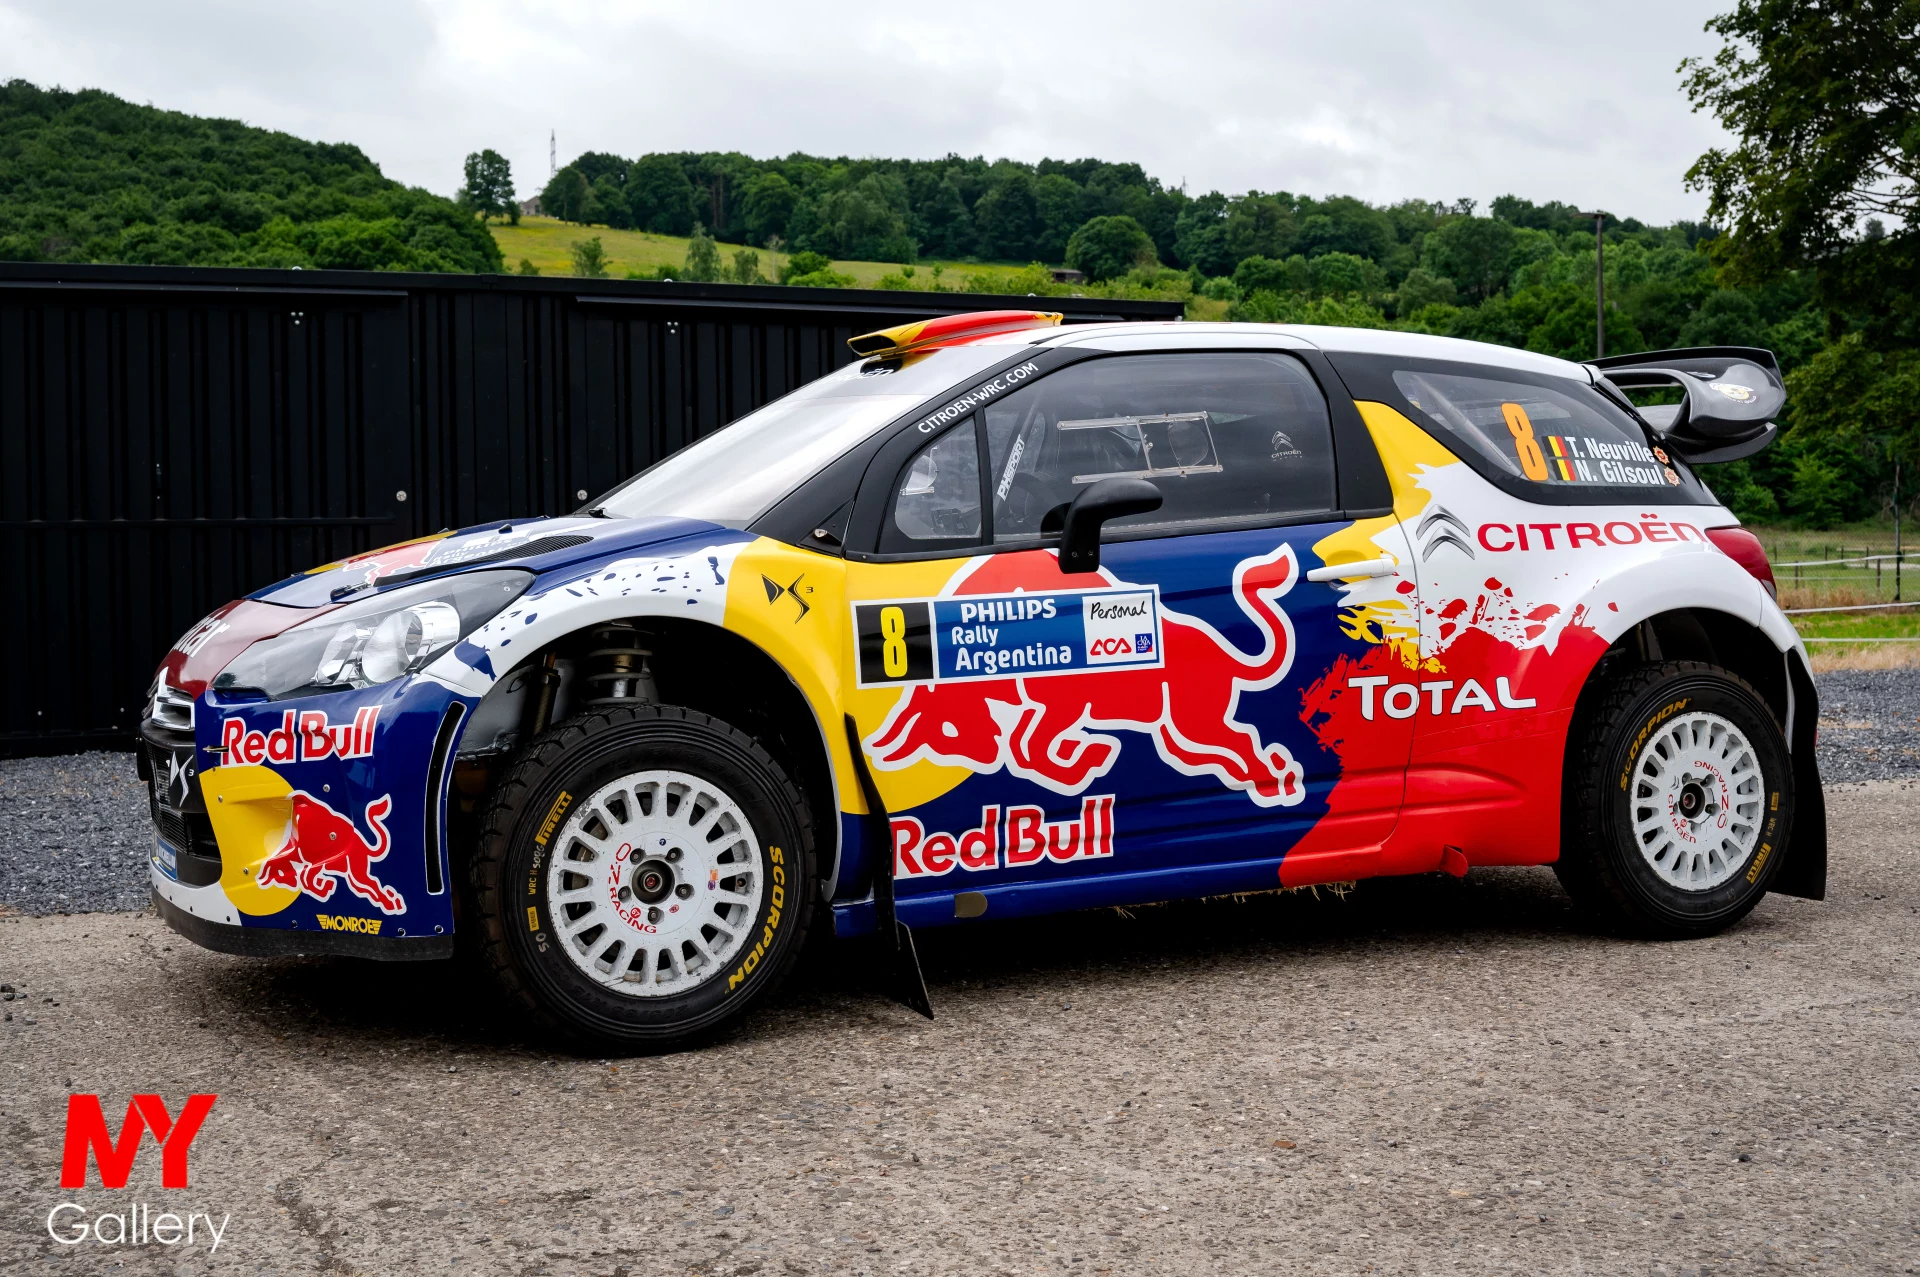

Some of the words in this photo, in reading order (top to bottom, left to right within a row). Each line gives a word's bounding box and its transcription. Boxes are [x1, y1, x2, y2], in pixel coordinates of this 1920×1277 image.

[918, 362, 1039, 433] CITROEN-WRC.COM
[1501, 402, 1549, 482] 8
[1565, 436, 1586, 459] T.
[1583, 437, 1655, 463] Neuville
[1574, 459, 1599, 482] N.
[1600, 460, 1666, 485] Gilsoul
[961, 599, 1057, 623] PHILIPS
[1090, 600, 1147, 620] Personal
[880, 606, 908, 678] 8
[952, 625, 999, 647] Rally
[956, 643, 1072, 675] Argentina
[1348, 675, 1537, 721] TOTAL
[221, 708, 297, 768] Red
[299, 705, 383, 761] Bull
[1620, 698, 1688, 791] SCORPION
[1694, 761, 1728, 793] RACING
[535, 790, 573, 846] PIRELLI
[891, 804, 1000, 880] Red
[1005, 794, 1116, 868] Bull
[1746, 842, 1772, 884] PIRELLI
[528, 877, 538, 896] WRC
[323, 916, 377, 935] MONROE
[609, 886, 657, 934] RACING
[728, 845, 785, 991] SCORPION
